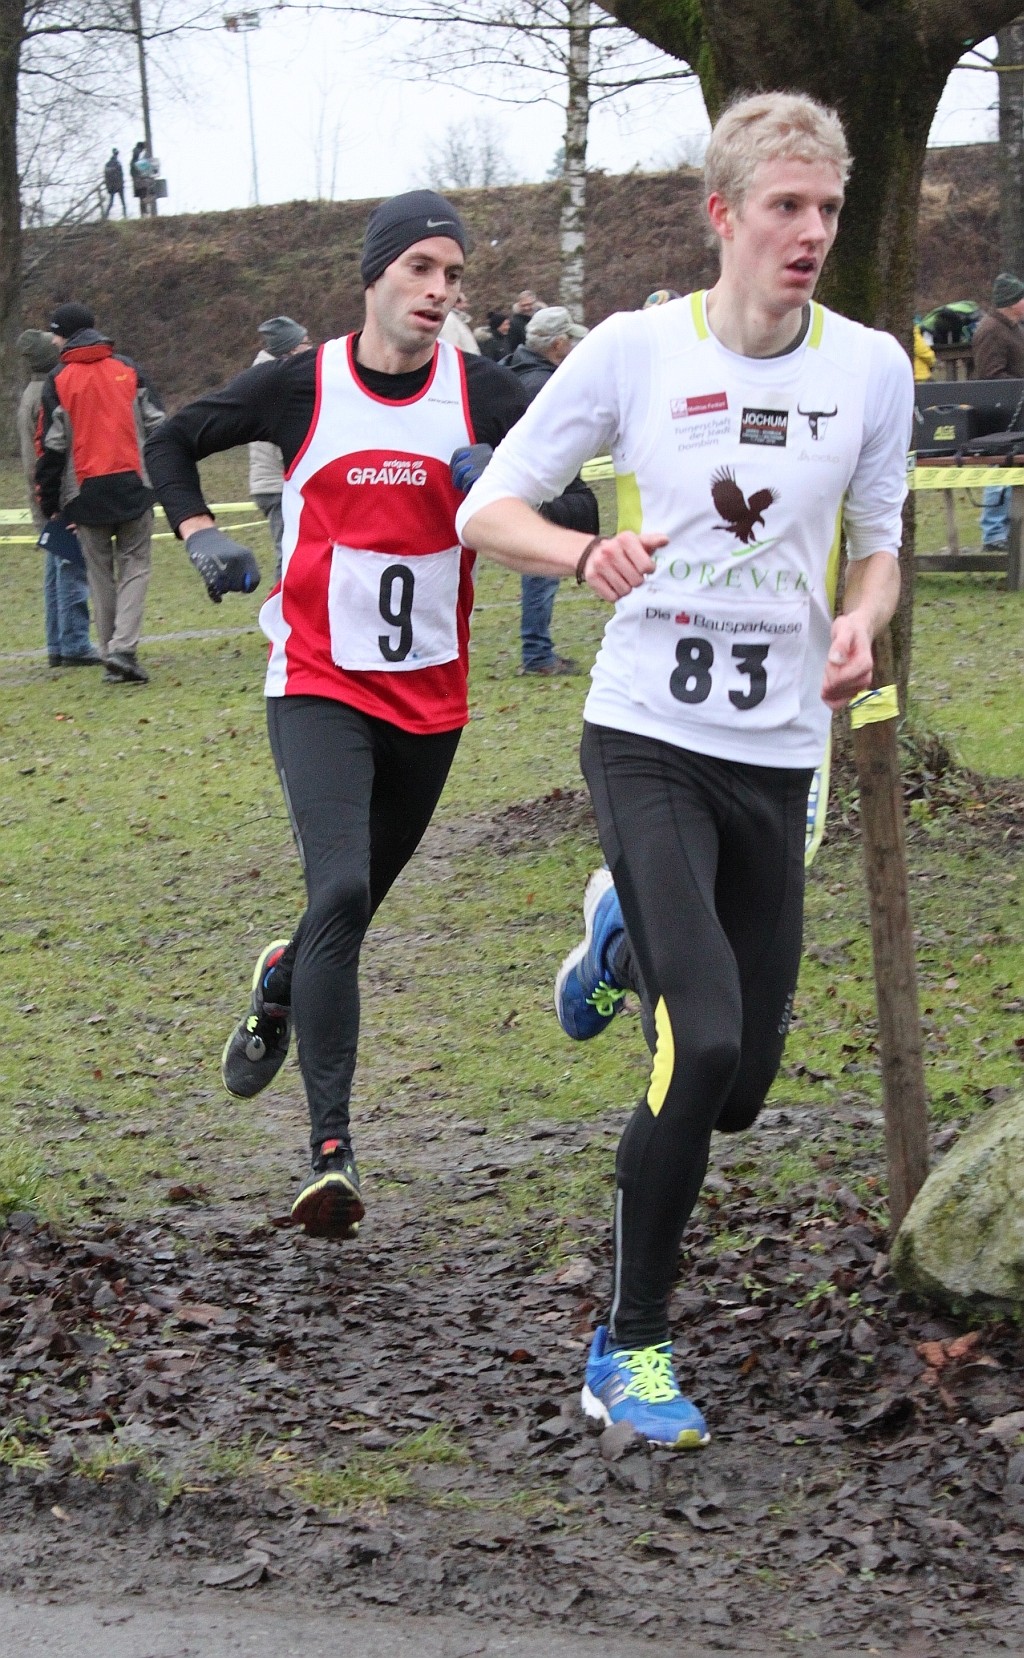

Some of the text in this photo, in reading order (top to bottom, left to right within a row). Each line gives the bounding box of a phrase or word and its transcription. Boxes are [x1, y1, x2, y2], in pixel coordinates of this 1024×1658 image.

[742, 412, 788, 428] JOCHUM
[383, 459, 411, 469] erdgas
[346, 468, 428, 486] GRAVAG
[377, 564, 415, 662] 9
[645, 607, 802, 635] Die Bausparkasse
[669, 637, 771, 711] 83
